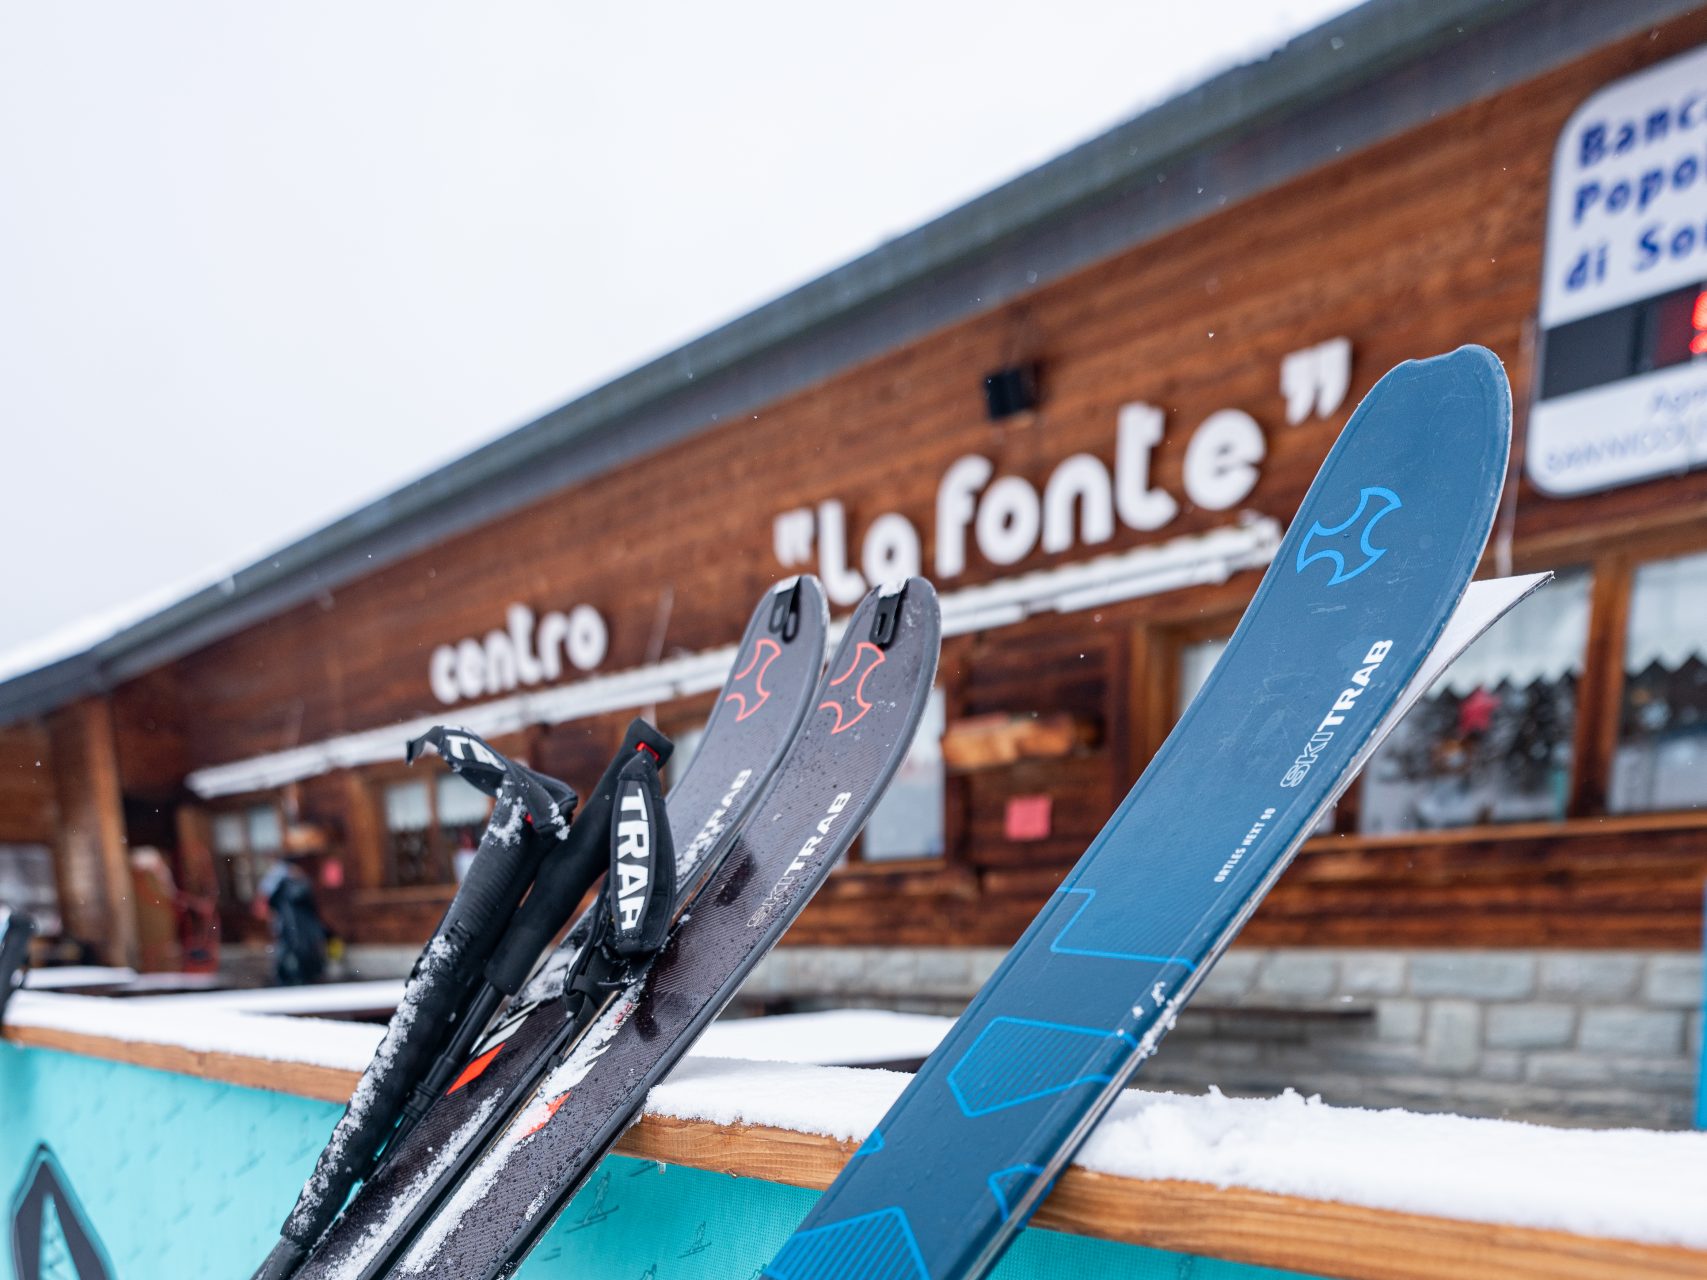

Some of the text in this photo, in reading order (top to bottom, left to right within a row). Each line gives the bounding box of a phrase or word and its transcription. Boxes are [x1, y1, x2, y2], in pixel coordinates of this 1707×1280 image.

[1566, 243, 1607, 293] di
[428, 603, 609, 704] centro
[1279, 639, 1394, 788] SKITRAB
[746, 792, 853, 927] SKITRAB
[1241, 822, 1266, 846] NEXT
